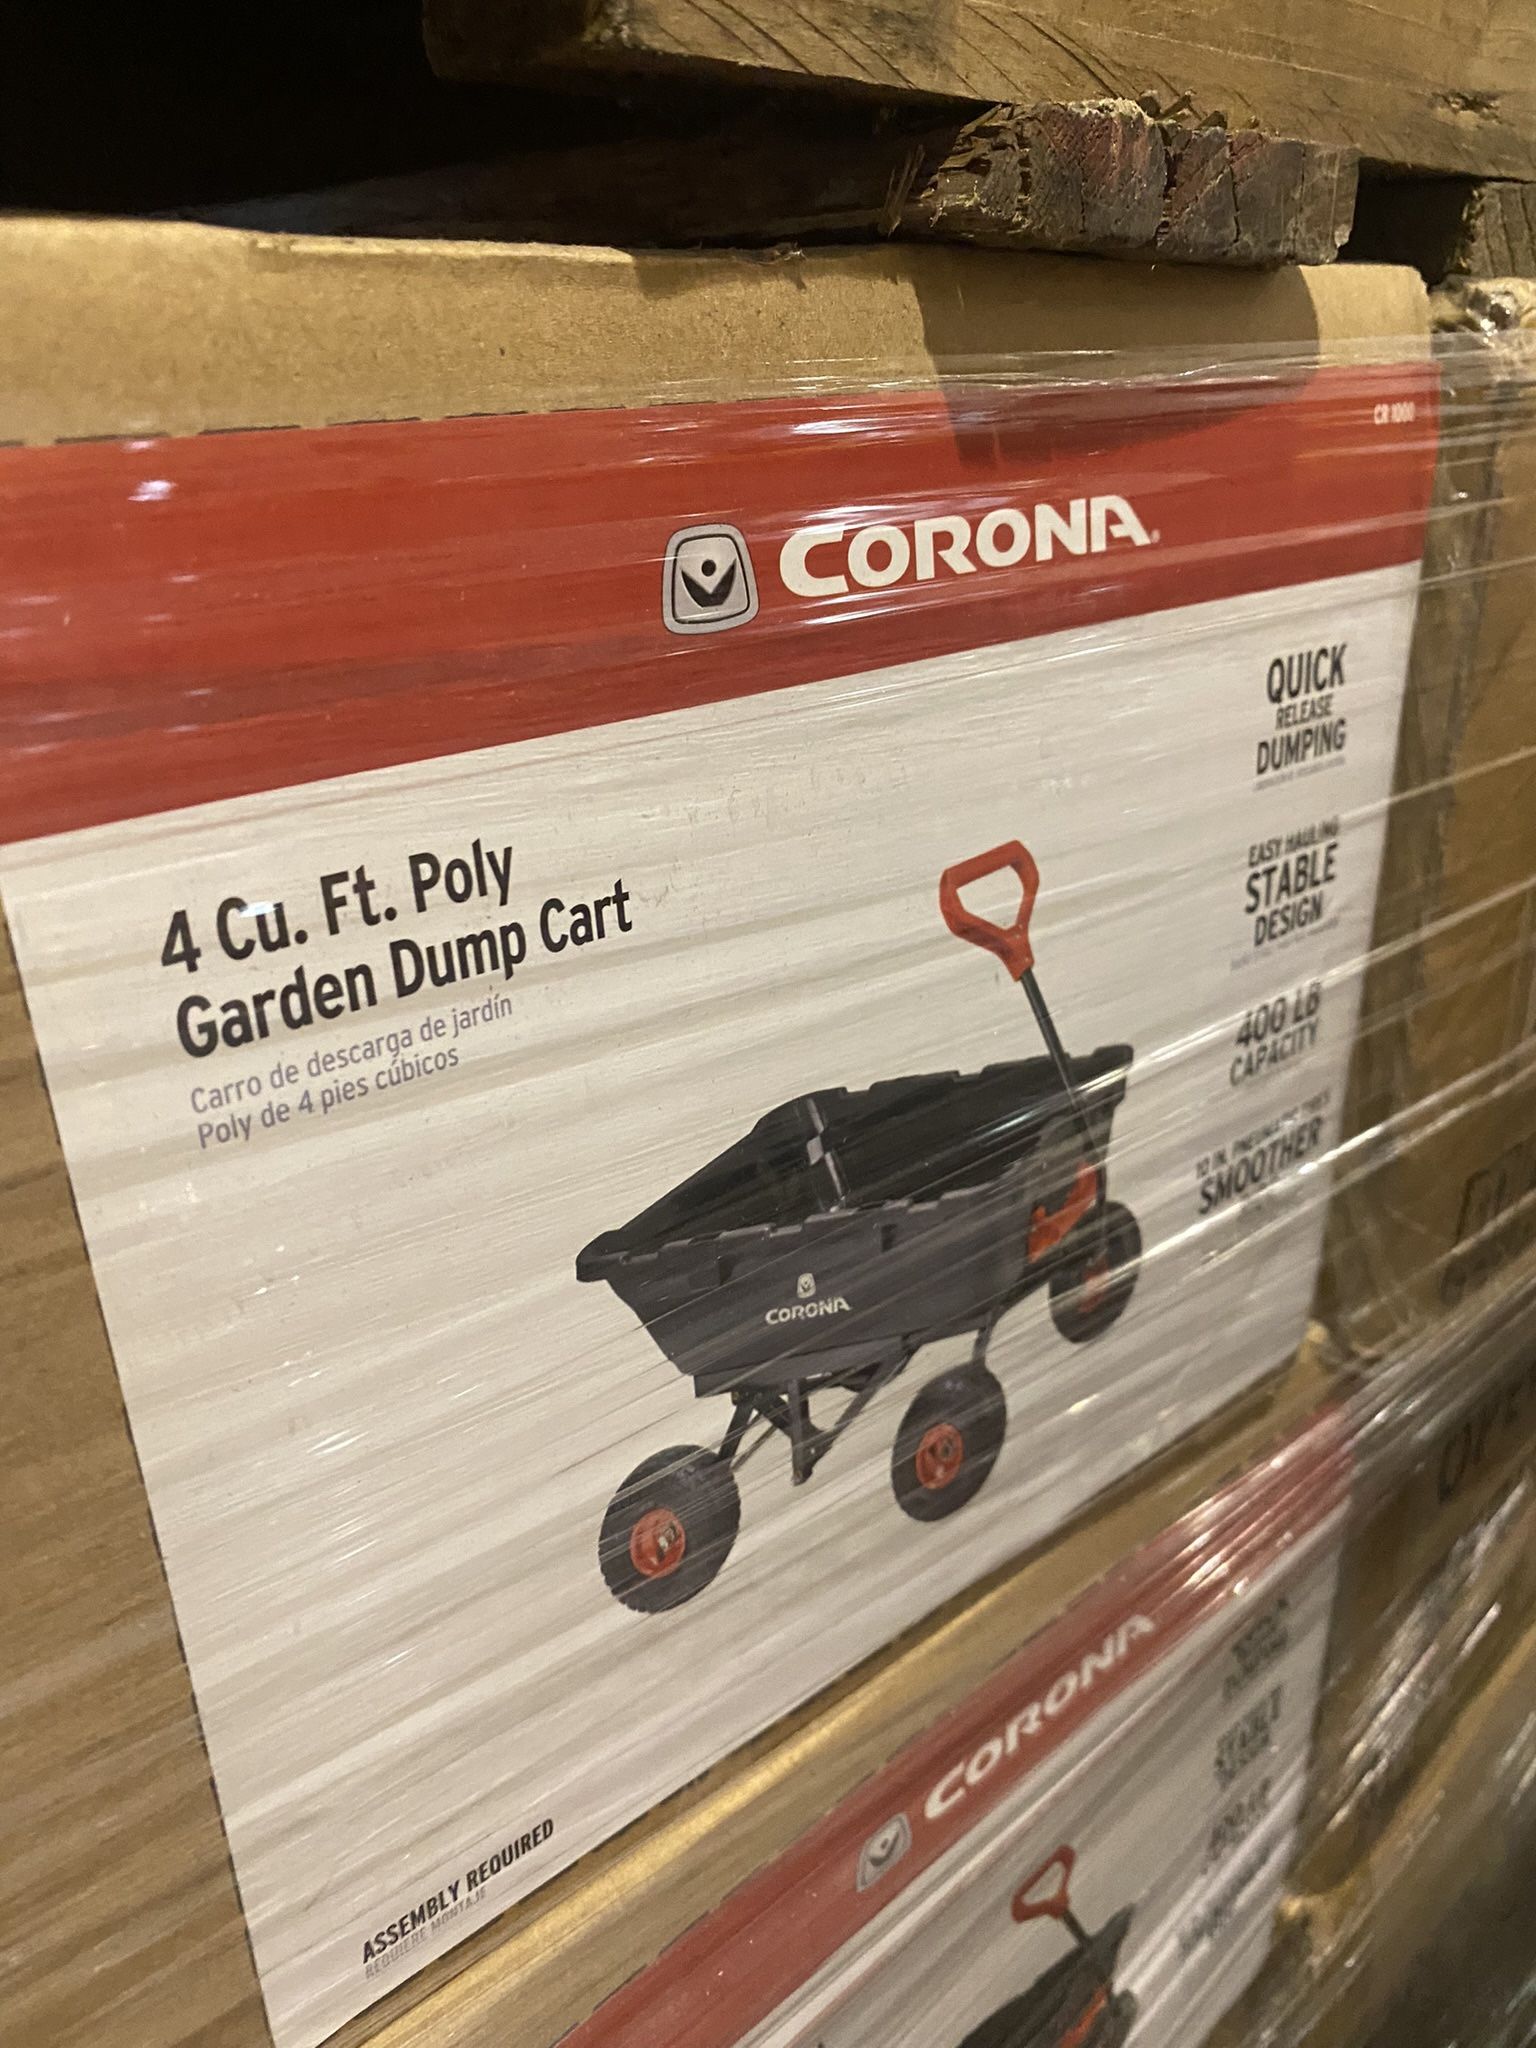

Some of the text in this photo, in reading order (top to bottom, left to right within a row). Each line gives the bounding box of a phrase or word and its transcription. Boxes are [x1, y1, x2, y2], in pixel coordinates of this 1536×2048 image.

[779, 494, 1152, 598] CORONA
[1266, 642, 1348, 703] QUICK
[1256, 717, 1347, 775] DUMPING
[1275, 693, 1334, 730] RELEASE
[1244, 842, 1340, 914] STABLE
[1247, 837, 1283, 868] EASY
[160, 837, 513, 974] 4 Cu. Ft. Poly
[1254, 890, 1324, 948] DESIGN
[176, 878, 634, 1058] Garden Dump Cart
[190, 994, 513, 1114] Carro de descarga de jardín
[1229, 1016, 1319, 1086] CAPACITY
[1236, 996, 1287, 1048] 400
[198, 1045, 459, 1150] Poly de 4 pies cúbicos
[1198, 1115, 1324, 1215] SMOOTHER
[765, 1296, 852, 1325] CORONA
[923, 1614, 1157, 1820] CORONA
[362, 1818, 555, 1965] ASSEMBLY REQUIRED
